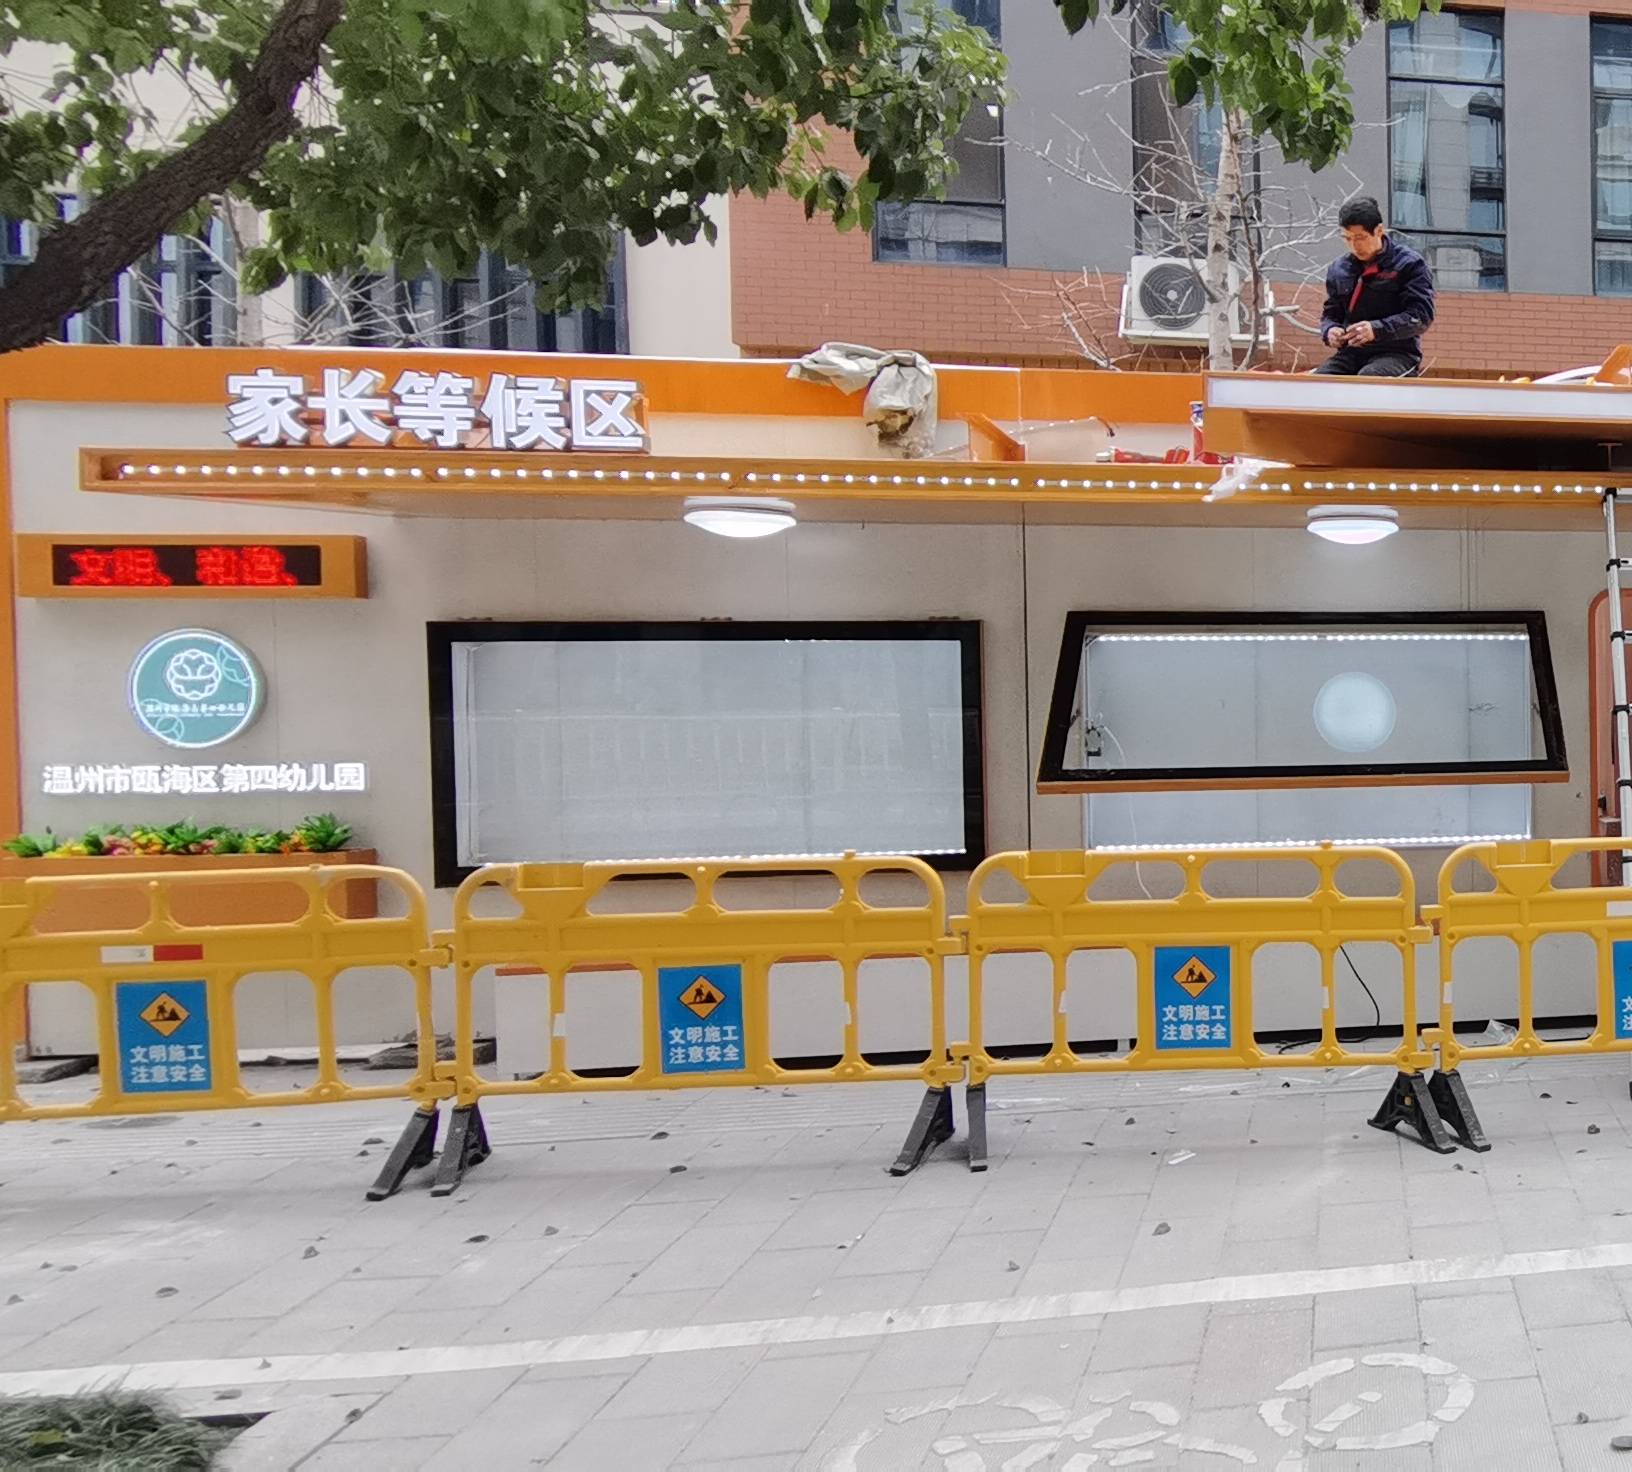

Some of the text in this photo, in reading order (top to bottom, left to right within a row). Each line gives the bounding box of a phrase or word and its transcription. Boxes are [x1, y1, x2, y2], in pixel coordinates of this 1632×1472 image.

[227, 368, 646, 452] 家长等候区
[43, 763, 366, 793] 温州市瓯海区第四幼儿园
[1162, 1004, 1226, 1021] 文明施工
[668, 1025, 739, 1044] 文明施工
[1162, 1023, 1227, 1041] 注意安全
[130, 1044, 205, 1063] 文明施工
[669, 1044, 740, 1064] 注意安全
[130, 1064, 207, 1083] 注意安全
